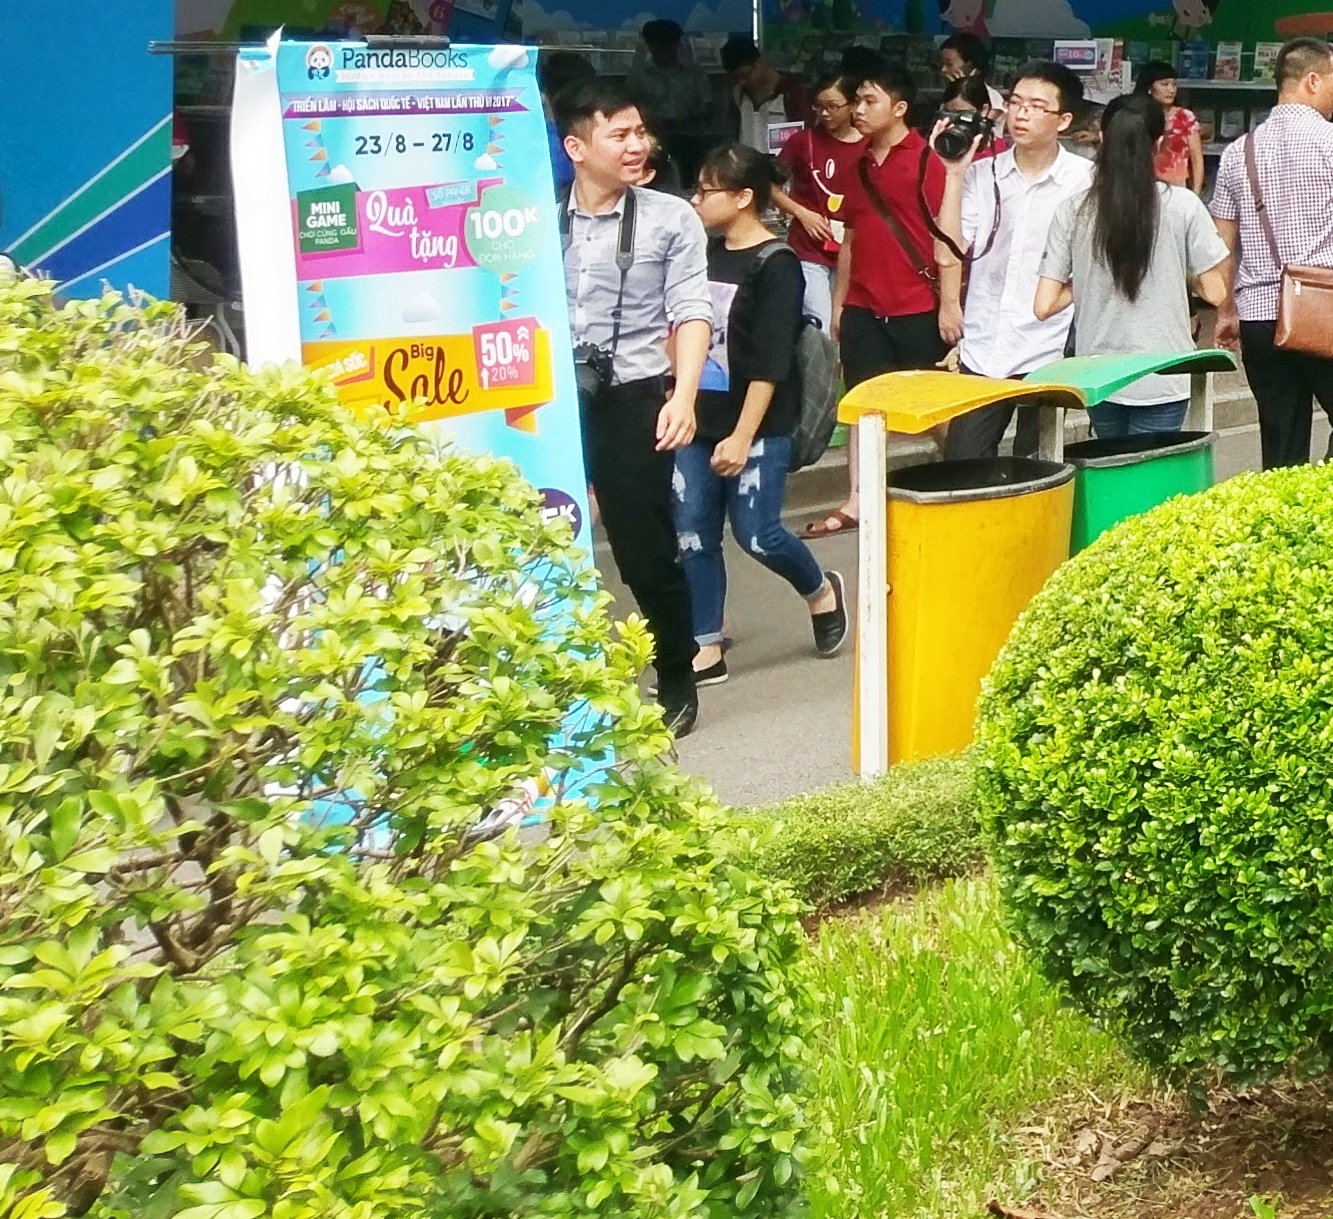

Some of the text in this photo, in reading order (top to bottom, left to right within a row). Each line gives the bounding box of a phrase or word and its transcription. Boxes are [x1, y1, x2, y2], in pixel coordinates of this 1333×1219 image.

[342, 47, 468, 68] PandaBooks
[357, 95, 379, 111] SÁCH
[380, 94, 400, 110] QUỐC
[418, 95, 435, 112] VIỆT
[435, 97, 451, 110] NAM
[355, 132, 406, 156] 23/8
[432, 131, 474, 153] 27/8
[311, 201, 340, 215] MINI
[366, 190, 418, 237] Quà
[306, 213, 346, 229] GAME
[315, 237, 339, 246] PANDA
[409, 227, 458, 269] tặng
[491, 241, 516, 252] CHO
[410, 343, 434, 361] Big
[481, 333, 530, 368] 50%
[383, 346, 470, 416] Sale
[491, 365, 519, 382] 20%
